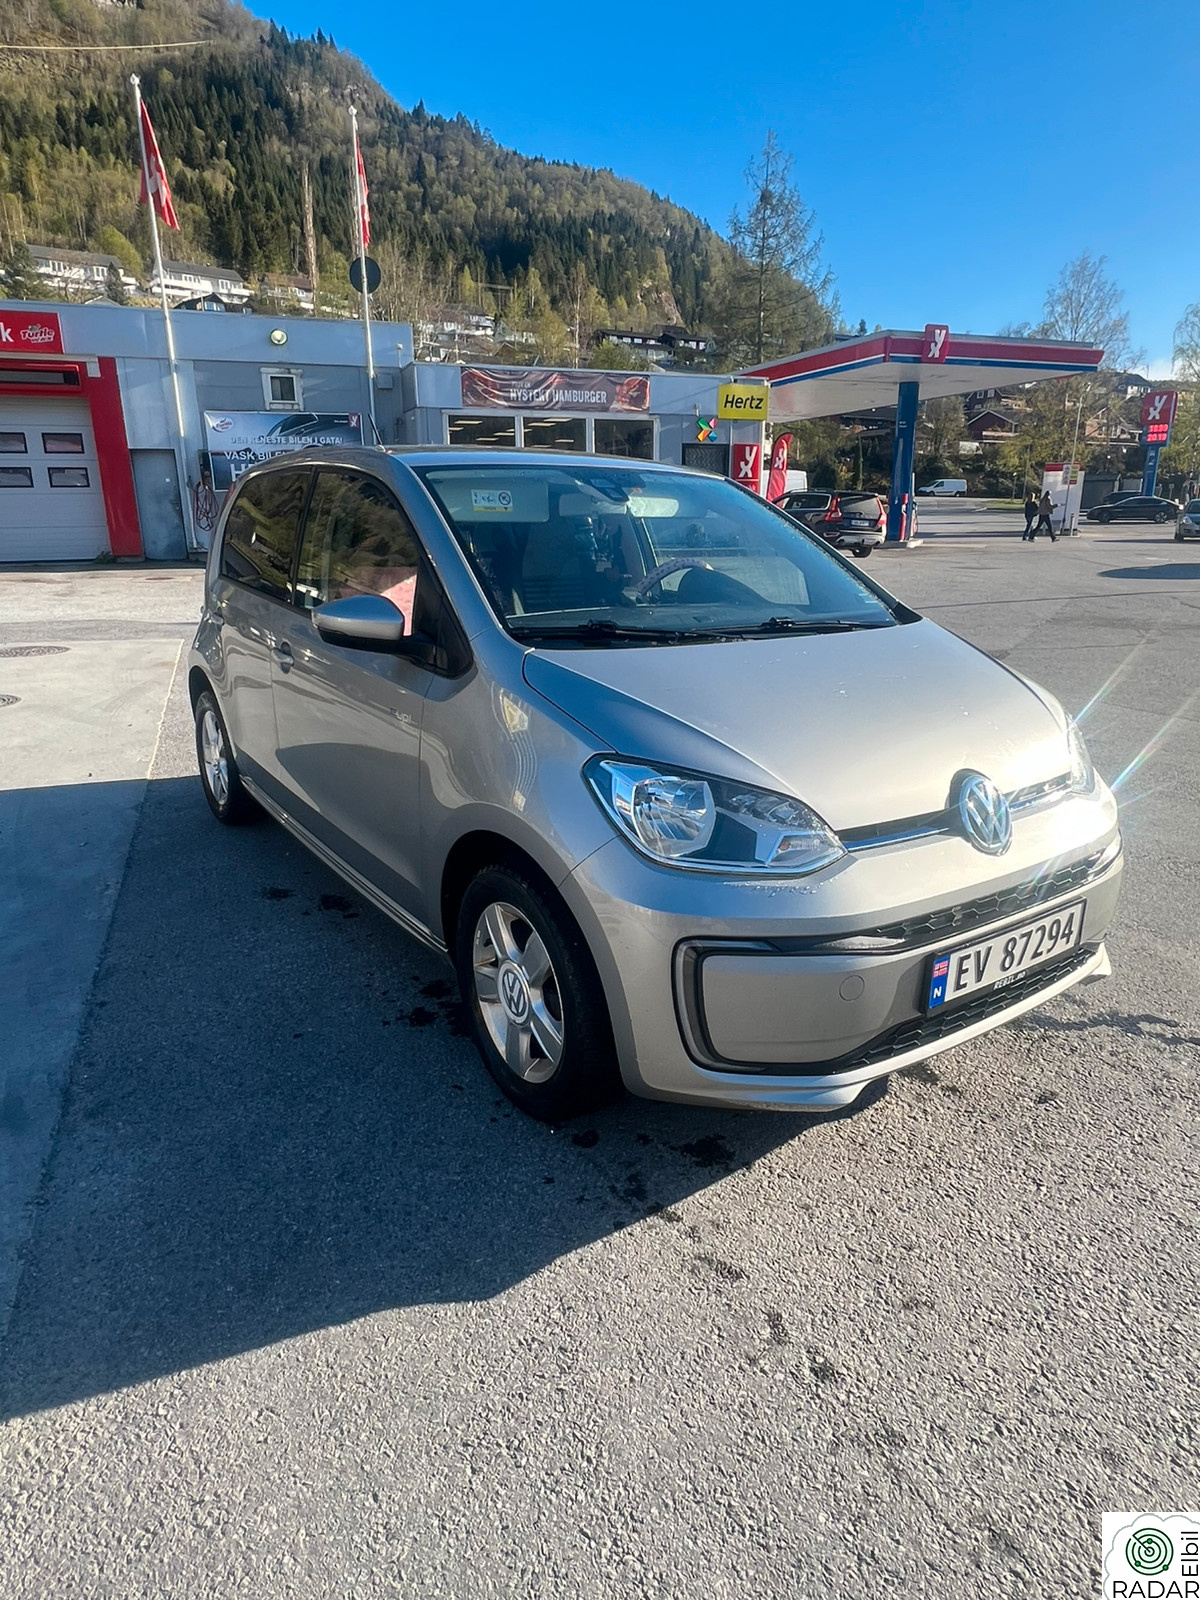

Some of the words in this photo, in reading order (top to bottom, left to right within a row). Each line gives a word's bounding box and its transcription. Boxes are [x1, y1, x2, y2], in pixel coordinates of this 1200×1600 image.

[20, 327, 55, 340] Turtle
[552, 389, 607, 403] HAMBURGER
[724, 394, 764, 410] Hertz
[320, 437, 343, 445] GATA!
[224, 451, 255, 460] VASK
[953, 945, 993, 993] EV
[1000, 912, 1075, 973] 87294
[933, 986, 942, 999] N
